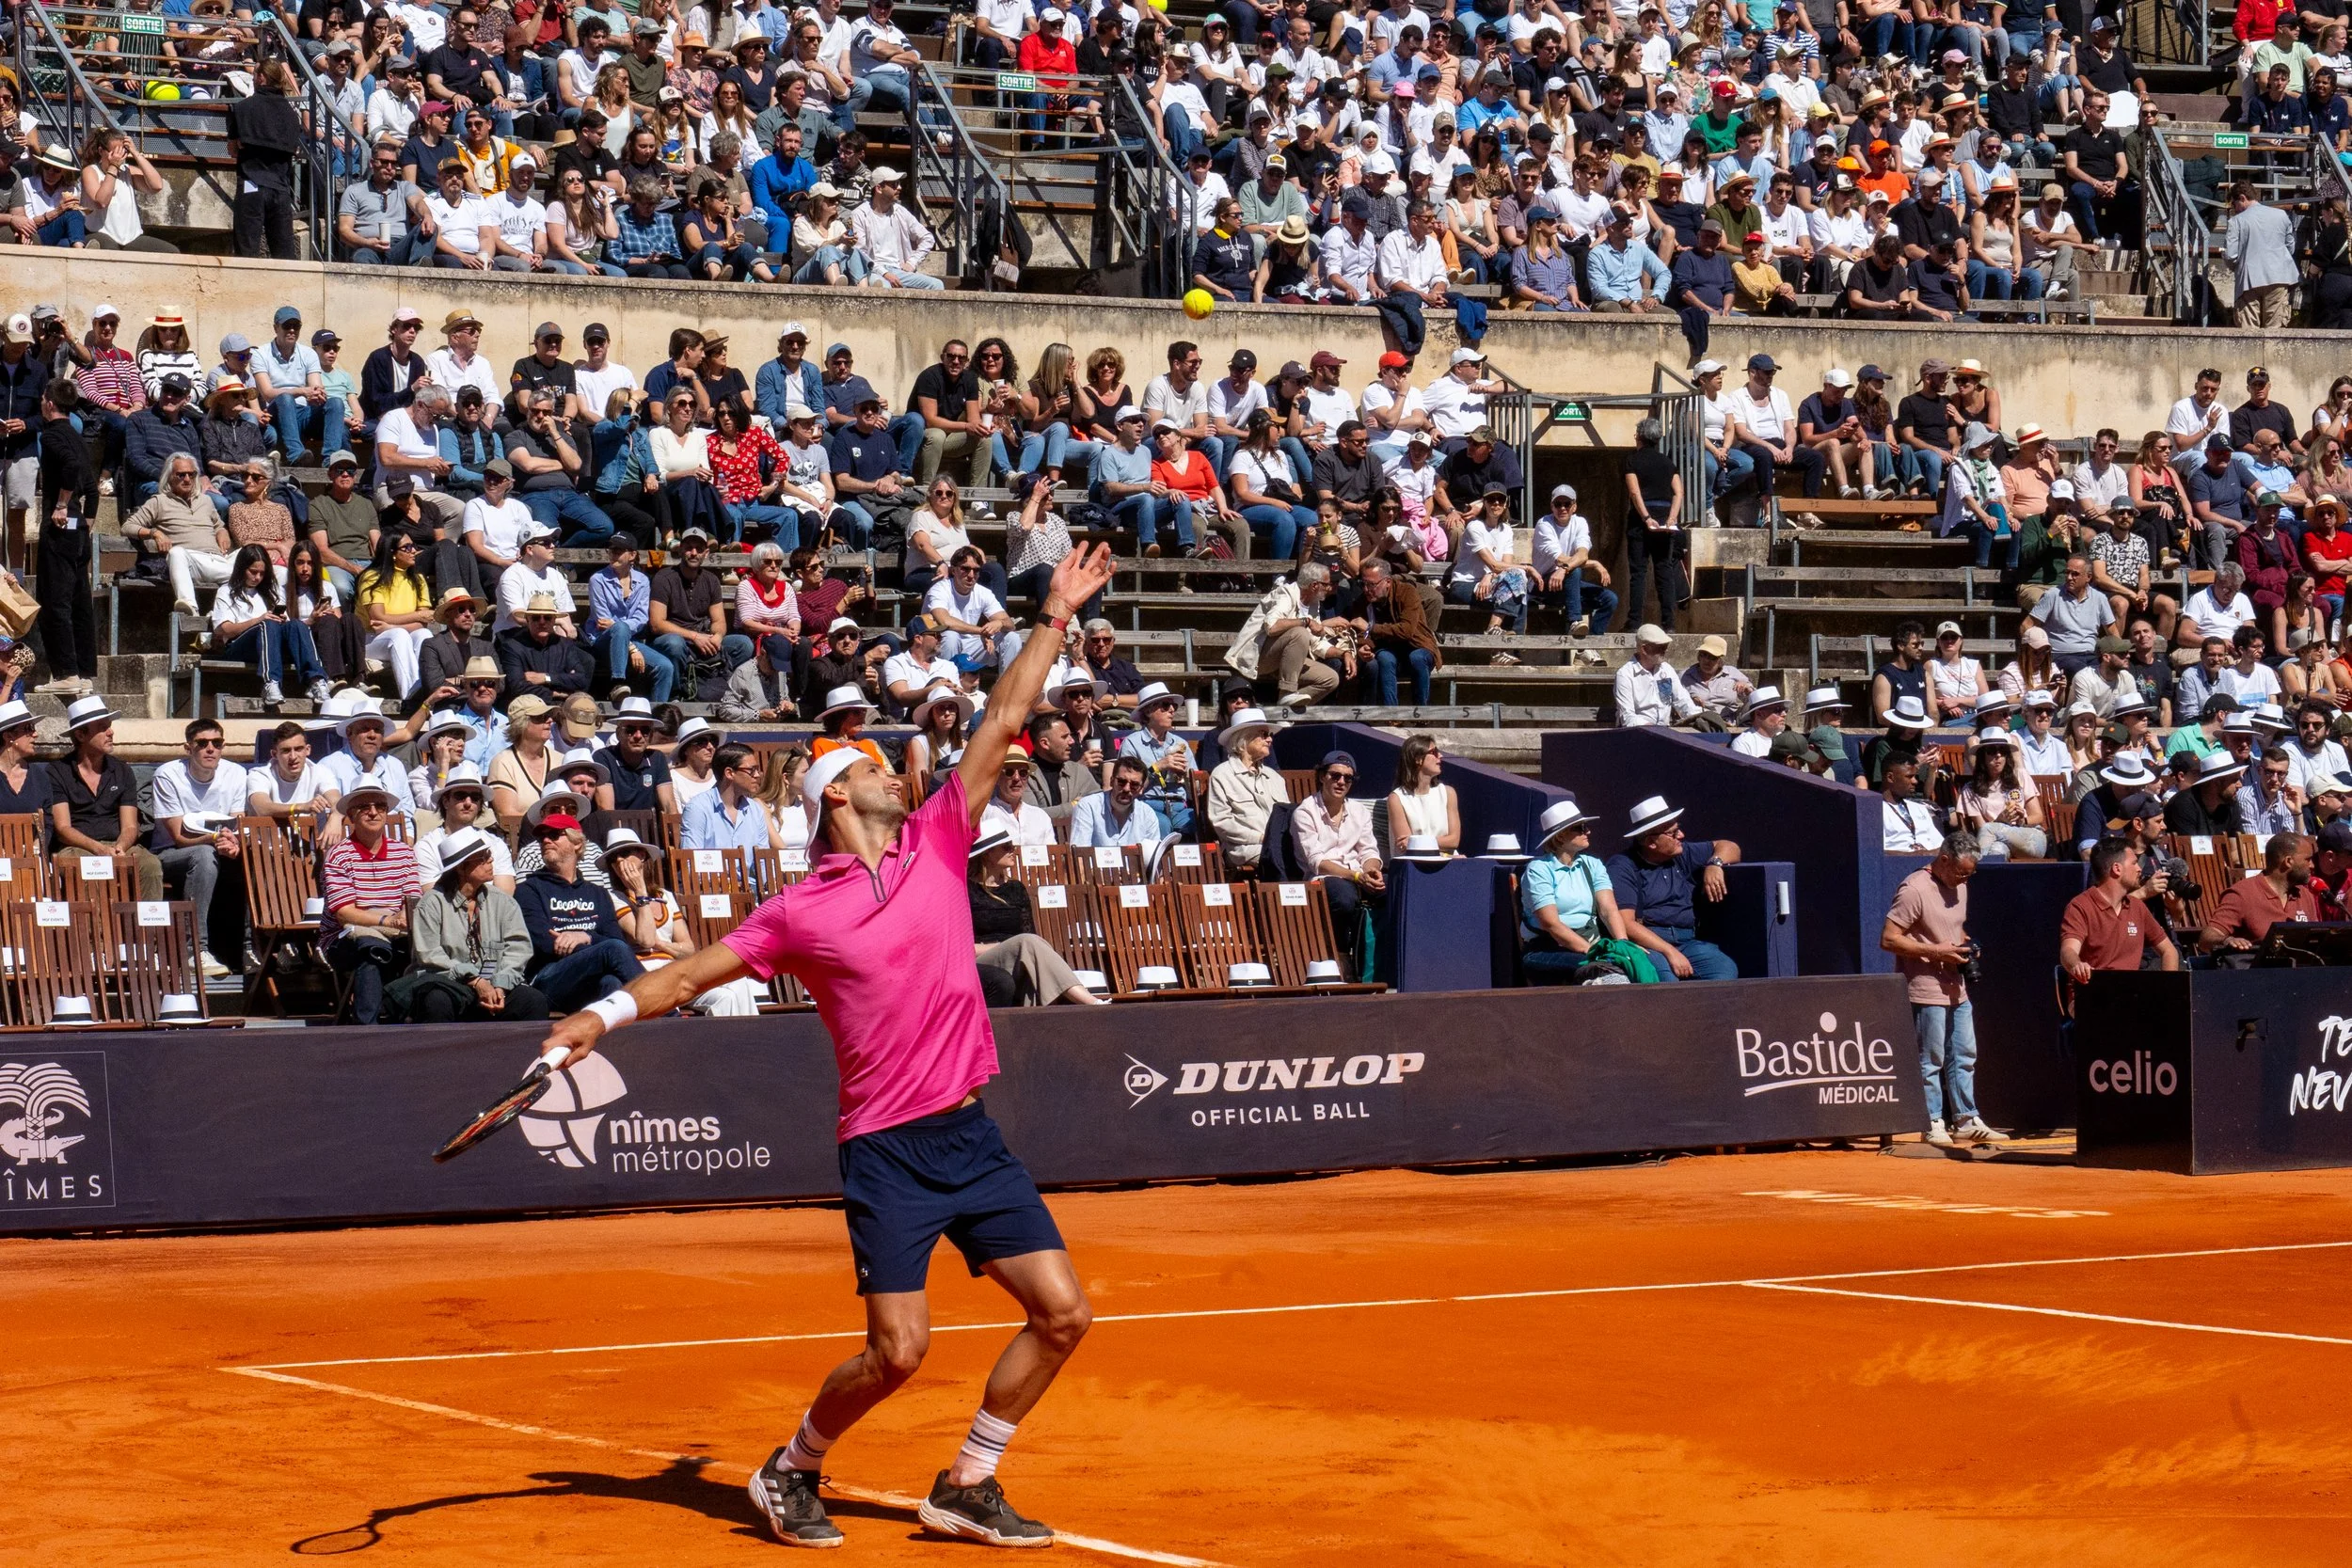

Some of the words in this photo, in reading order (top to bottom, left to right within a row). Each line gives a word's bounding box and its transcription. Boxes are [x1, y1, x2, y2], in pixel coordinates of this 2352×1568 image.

[126, 18, 161, 32] SORTIE
[1001, 76, 1033, 88] SORTIE
[2217, 136, 2244, 145] SORTIE
[1806, 295, 1817, 306] 19
[1771, 568, 1785, 578] 70
[1836, 638, 1849, 650] 24
[1281, 708, 1289, 719] 8
[1351, 708, 1362, 721] 7
[1413, 707, 1421, 719] 6
[1462, 707, 1470, 718] 5
[1524, 707, 1534, 719] 4
[550, 896, 595, 911] Cocorico
[1735, 1010, 1895, 1078] Bastide
[2318, 1015, 2352, 1063] TE
[1173, 1052, 1425, 1095] DUNLOP
[2089, 1050, 2178, 1096] celio
[1819, 1082, 1899, 1105] MÉDICAL
[2289, 1066, 2352, 1116] NEV
[1191, 1104, 1302, 1127] OFFICIAL
[1313, 1101, 1371, 1120] BALL
[610, 1110, 721, 1145] nîmes
[612, 1139, 771, 1176] métropole
[3, 1167, 103, 1201] ÎMES
